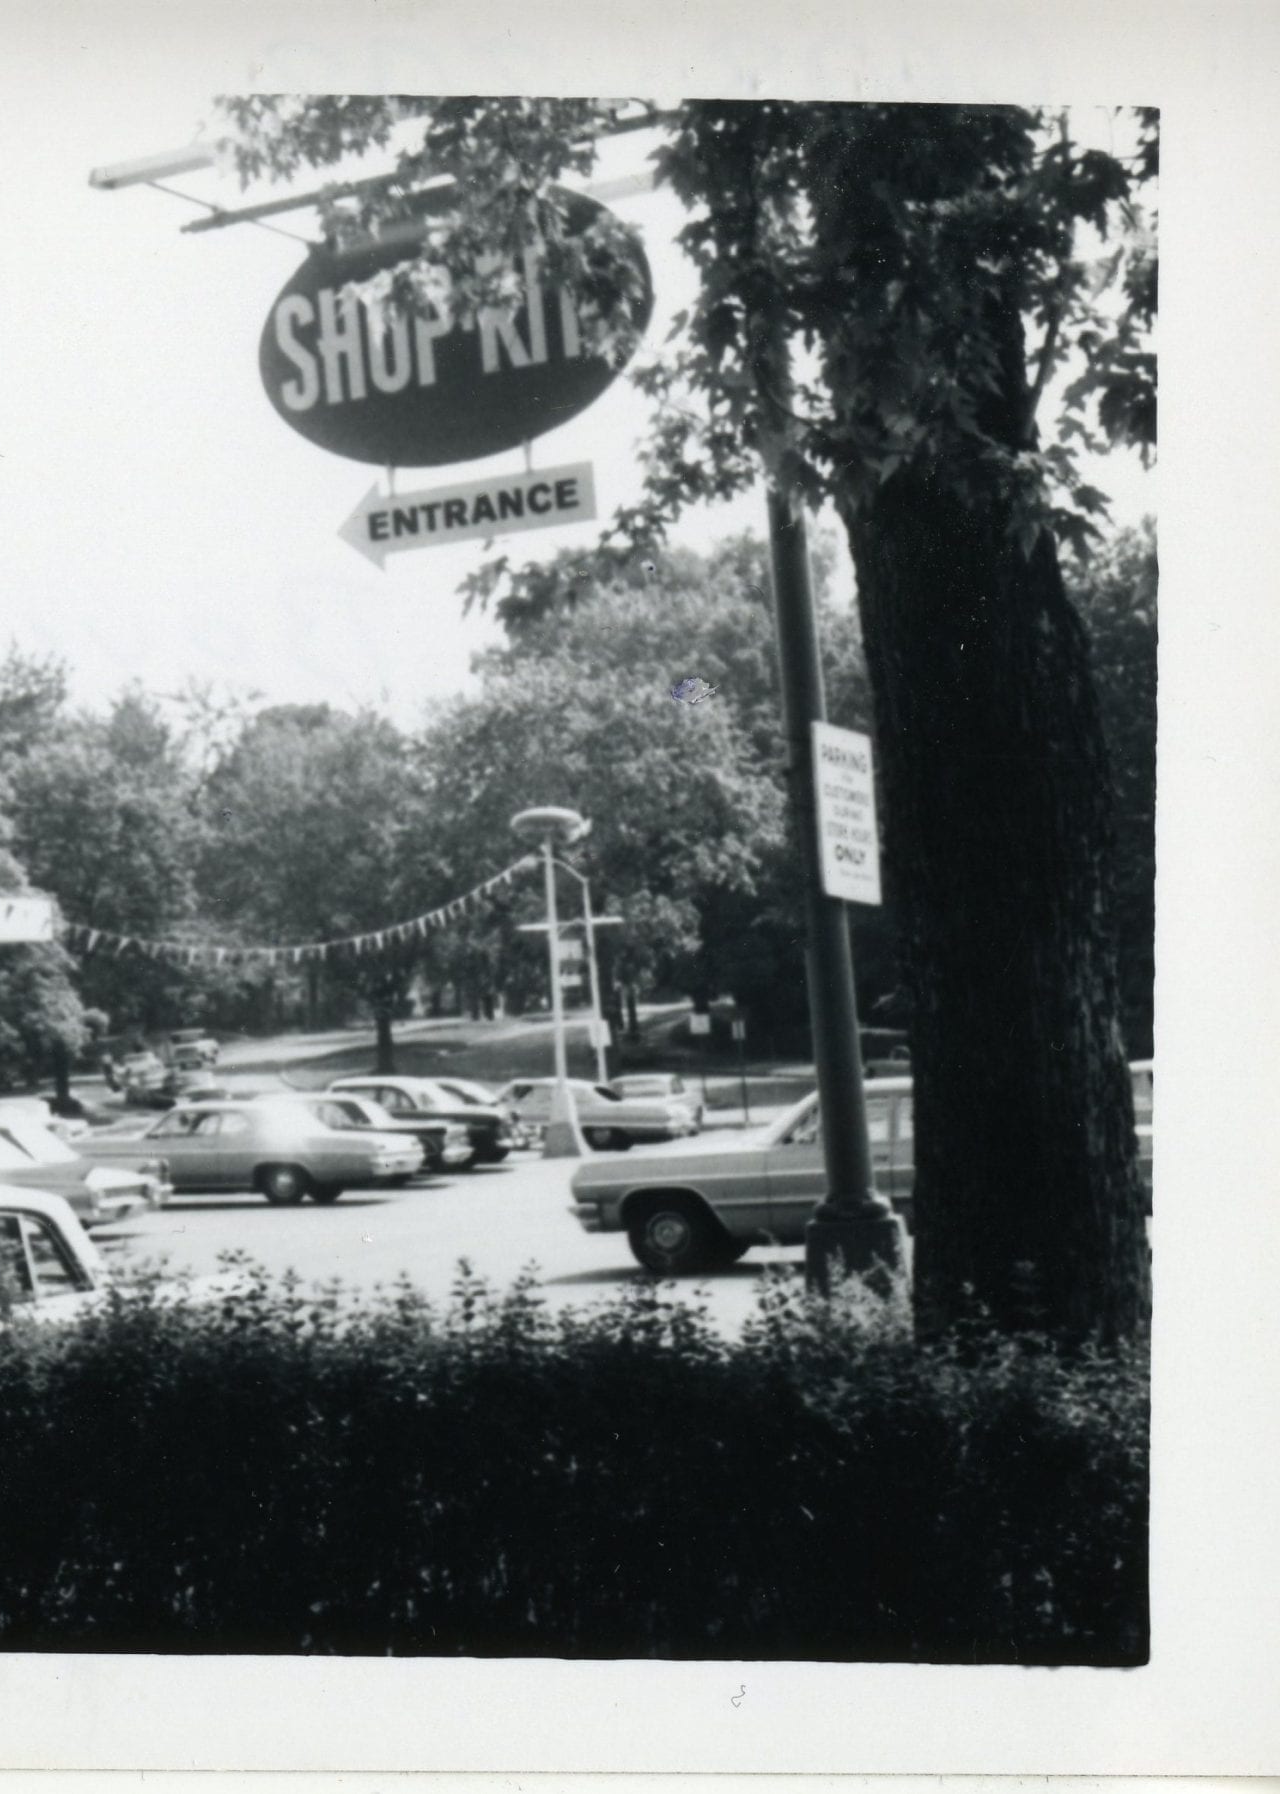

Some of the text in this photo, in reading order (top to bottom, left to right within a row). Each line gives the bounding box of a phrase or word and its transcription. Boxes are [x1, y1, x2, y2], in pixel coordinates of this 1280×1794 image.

[274, 261, 454, 412] SHOP
[368, 478, 580, 541] ENTRANCE
[820, 744, 868, 774] PARKING
[835, 845, 867, 866] ONLY
